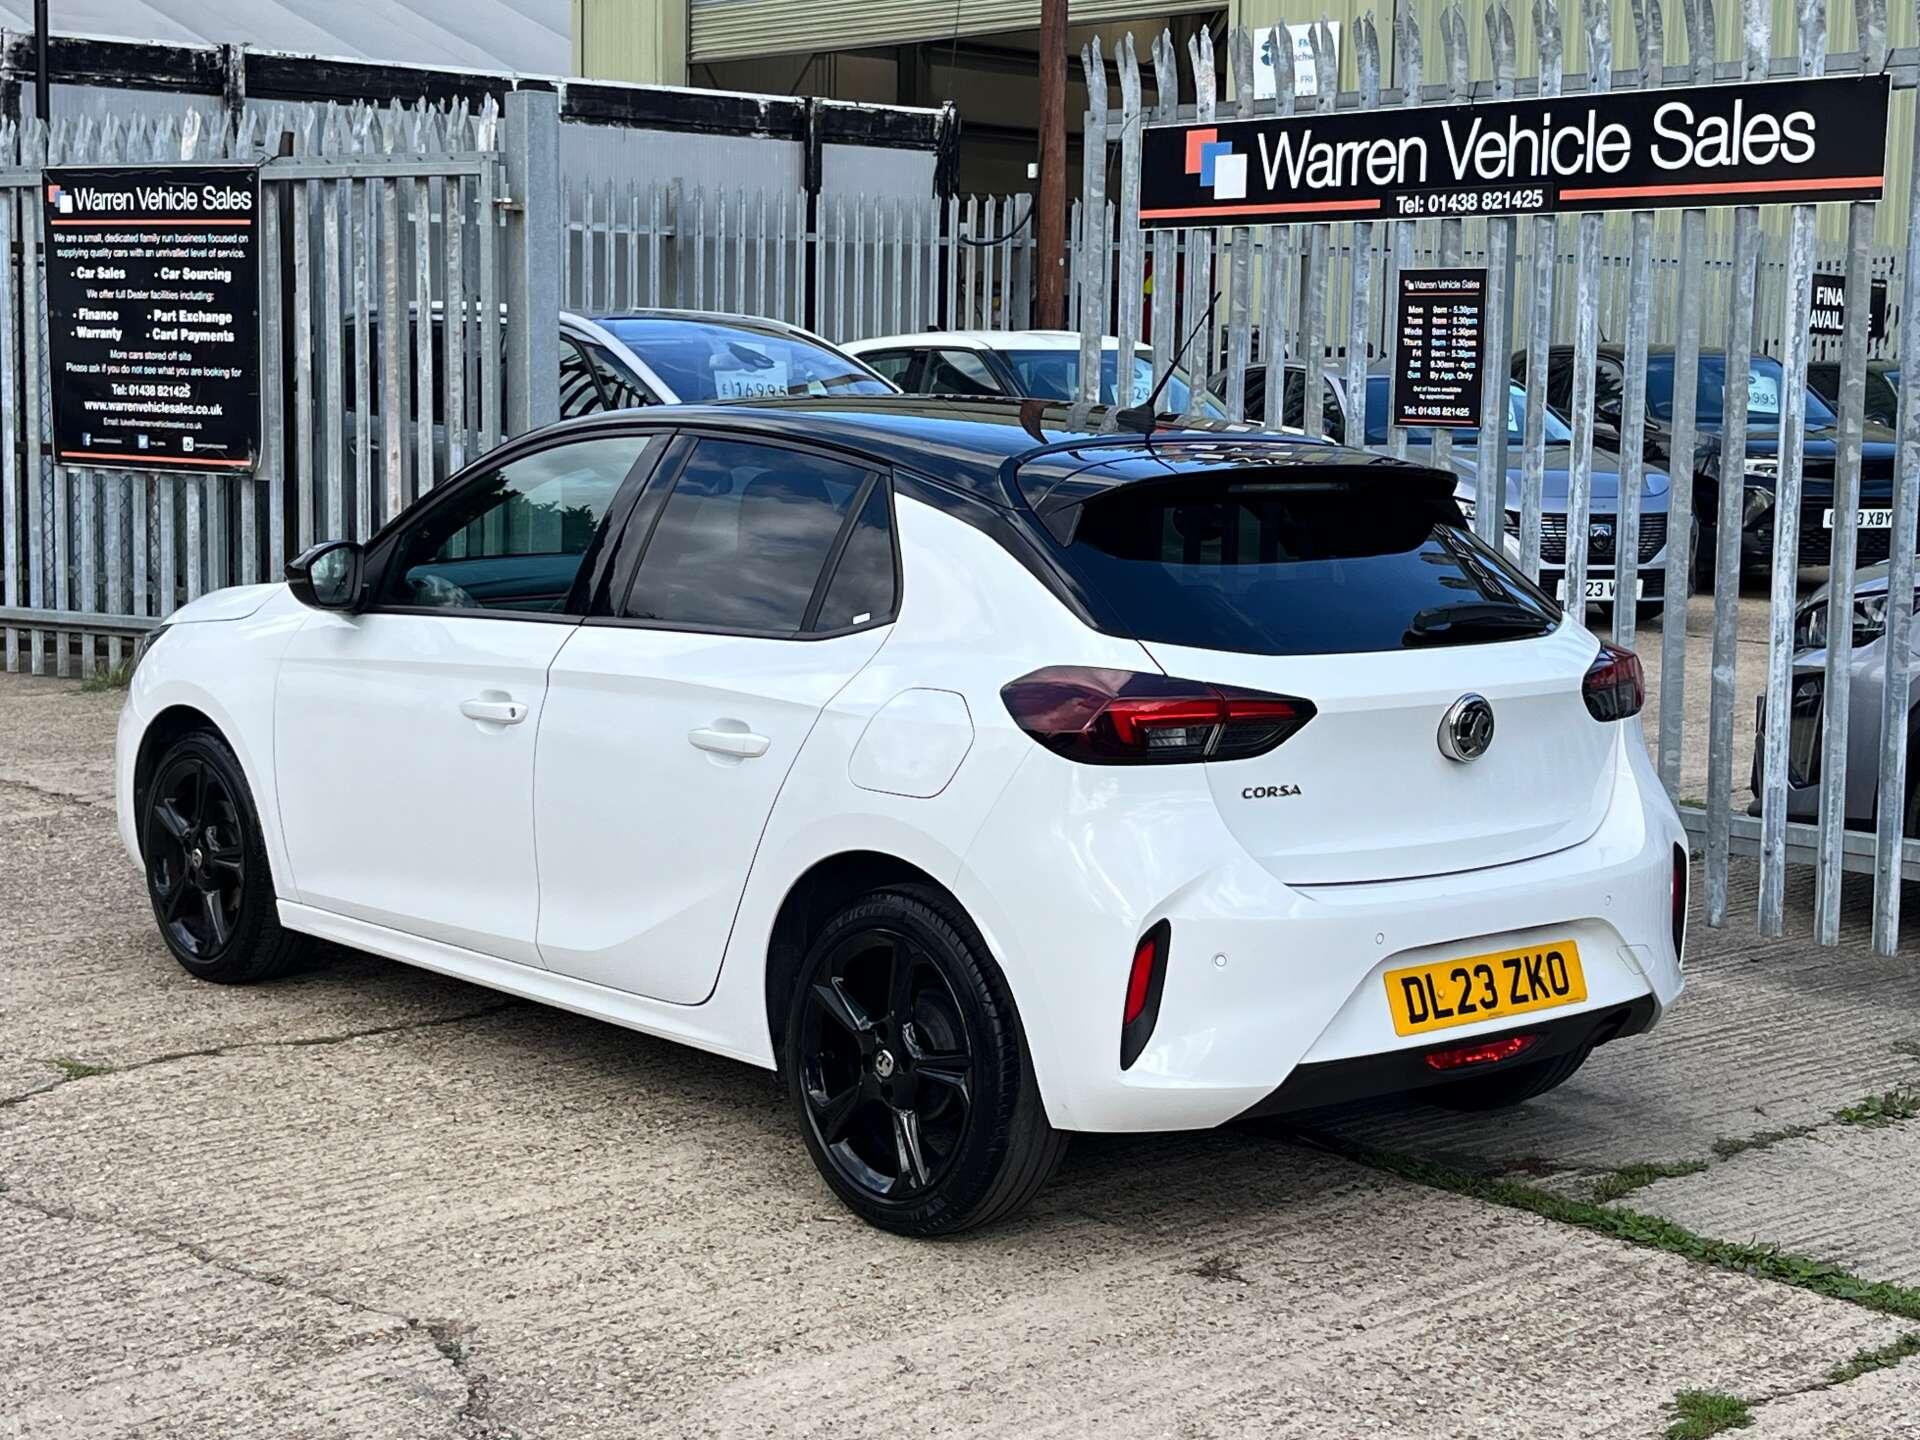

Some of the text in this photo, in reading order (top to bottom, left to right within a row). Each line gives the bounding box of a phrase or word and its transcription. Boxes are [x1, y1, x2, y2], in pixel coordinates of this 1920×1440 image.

[1257, 98, 1816, 190] Warren Vehicle Sales
[74, 185, 252, 211] Warren Vehicle Sales
[1396, 189, 1543, 214] Tel: 01438 821425
[53, 233, 65, 243] We
[66, 234, 77, 243] are
[78, 234, 83, 243] a
[104, 233, 139, 243] dedicated
[140, 233, 160, 245] family
[162, 234, 174, 243] run
[175, 233, 206, 243] business
[207, 233, 237, 243] focused
[238, 235, 248, 243] on
[57, 248, 89, 259] supplying
[90, 248, 112, 259] quality
[113, 249, 128, 257] cars
[130, 248, 144, 257] with
[145, 249, 154, 257] an
[190, 248, 207, 257] level
[208, 248, 217, 257] of
[217, 248, 246, 258] service.
[76, 266, 126, 280] Car Sales
[160, 267, 232, 283] Car Sourcing
[1414, 280, 1480, 289] Warren Vehicle Sales
[86, 289, 97, 298] We
[99, 289, 114, 299] offer
[115, 289, 126, 299] full
[127, 289, 149, 299] Dealer
[150, 290, 178, 300] facilities
[1816, 286, 1844, 307] FINA
[78, 308, 119, 321] Finance
[153, 309, 233, 325] Part Exchange
[1408, 305, 1423, 313] Mon
[1432, 305, 1447, 313] 9am
[1453, 305, 1478, 315] 5.30pm
[1407, 316, 1423, 324] Tues
[1432, 316, 1447, 324] 9am
[76, 326, 123, 342] Warranty
[152, 328, 235, 343] Card Payments
[110, 349, 192, 361] More cars stored off site
[1412, 349, 1421, 357] Fri
[1430, 349, 1445, 357] 9am
[66, 362, 242, 379] Please ask if you do not see what you are looking for
[1407, 370, 1421, 379] Sun
[1430, 371, 1439, 380] By
[1456, 371, 1473, 381] Only
[111, 383, 191, 398] Tel: 01438 821425
[84, 400, 223, 415] www.warrenvehiclesales.co.uk
[1404, 406, 1470, 417] Tel: 01438 821425
[1867, 511, 1893, 526] XBY
[1242, 784, 1302, 799] CORSA
[1401, 951, 1570, 1025] DL23 ZKO
